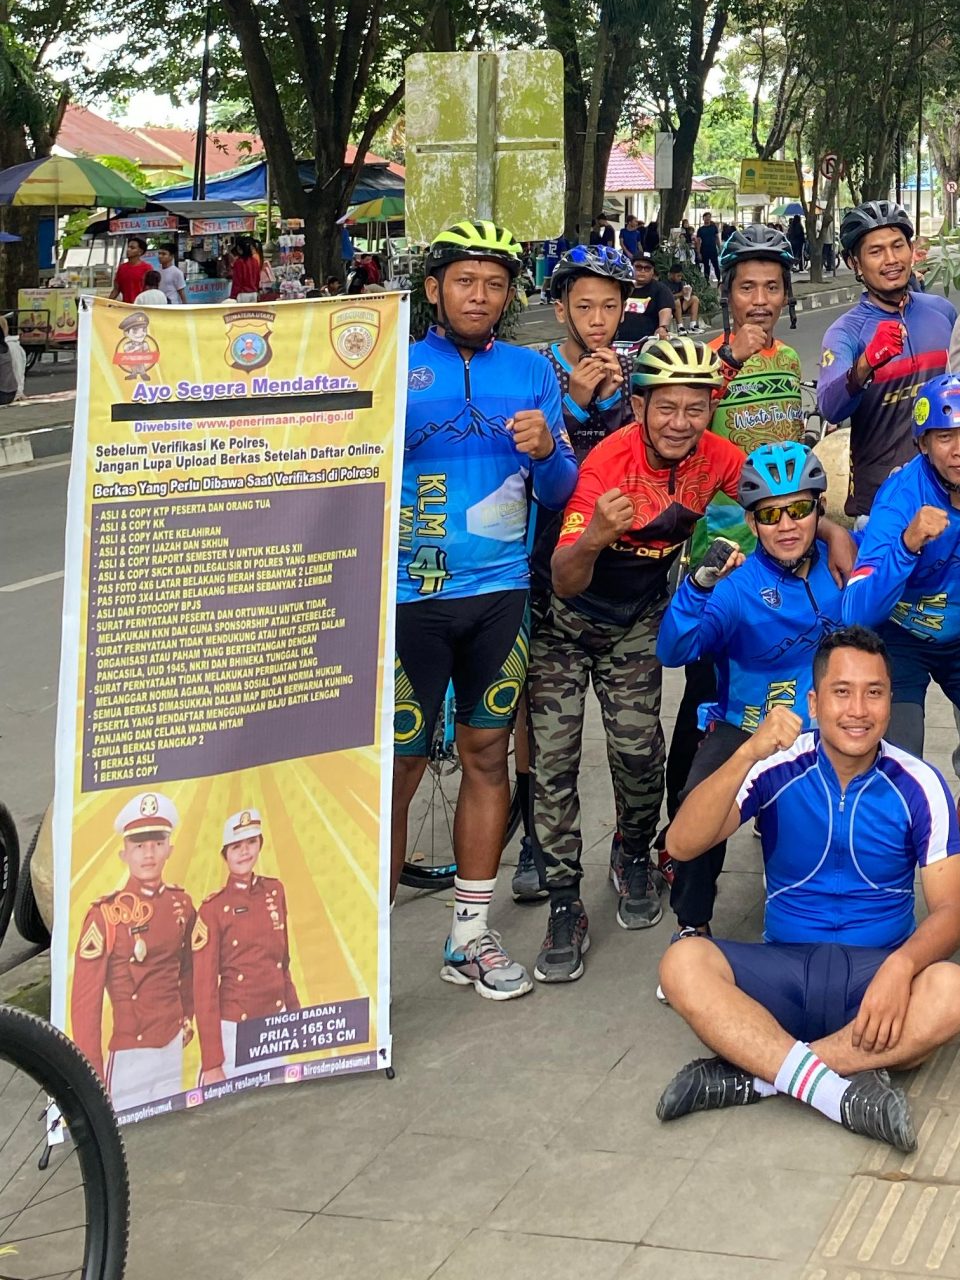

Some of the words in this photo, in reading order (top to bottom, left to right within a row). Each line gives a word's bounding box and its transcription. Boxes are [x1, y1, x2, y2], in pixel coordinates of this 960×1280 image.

[549, 244, 557, 254] 12
[133, 382, 171, 402] Ayo
[177, 379, 246, 400] Segera
[134, 420, 192, 432] Diwebsite
[196, 411, 353, 430] www.penerimaan.polri.go.id
[734, 410, 770, 430] Wisata
[96, 443, 147, 457] Sebelum
[151, 439, 206, 453] Verifikasi
[210, 438, 225, 450] Ke
[229, 436, 268, 451] Polres,
[95, 459, 138, 475] Jangan
[143, 457, 171, 472] Lupa
[176, 454, 216, 469] Upload
[220, 451, 260, 464] Berkas
[264, 448, 306, 461] Setelah
[310, 446, 344, 458] Daftar
[348, 443, 384, 455] Online.
[92, 482, 136, 498] Berkas
[138, 480, 168, 497] Yang
[170, 478, 200, 493] Perlu
[202, 475, 244, 491] Dibawa
[246, 473, 272, 487] Saat
[274, 469, 325, 485] Verifikasi
[327, 468, 337, 481] di
[339, 465, 371, 480] Polres
[100, 510, 118, 521] ASLI
[129, 507, 151, 518] COPY
[153, 506, 169, 516] KTP
[171, 503, 206, 515] PESERTA
[208, 502, 224, 512] DAN
[225, 500, 253, 511] ORANG
[255, 498, 270, 508] TUA
[416, 473, 447, 539] KLM
[407, 545, 452, 594] 4
[97, 608, 115, 620] ASLI
[117, 606, 134, 617] DAN
[136, 602, 178, 615] FOTOCOPY
[181, 599, 200, 610] BPJS
[93, 707, 121, 721] SEMUA
[124, 702, 156, 717] BERKAS
[159, 695, 212, 712] DIMASUKKAN
[214, 692, 241, 705] DALAM
[243, 690, 259, 701] MAP
[261, 687, 282, 698] BIOLA
[284, 679, 323, 694] BERWARNA
[324, 674, 353, 687] KUNING
[94, 730, 133, 746] PANJANG
[135, 728, 152, 740] DAN
[155, 723, 186, 737] CELANA
[188, 720, 217, 733] WARNA
[219, 717, 243, 730] HITAM
[91, 744, 120, 759] SEMUA
[122, 740, 155, 754] BERKAS
[157, 734, 197, 751] RANGKAP
[100, 755, 134, 770] BERKAS
[136, 753, 154, 765] ASLI
[100, 768, 133, 782] BERKAS
[136, 765, 157, 777] COPY
[265, 1012, 299, 1026] TINGGI
[302, 1006, 336, 1019] BADAN
[260, 1028, 290, 1043] PRIA
[301, 1022, 323, 1035] 165
[327, 1018, 346, 1030] CM
[249, 1039, 299, 1058] WANITA
[311, 1034, 332, 1046] 163
[336, 1029, 356, 1042] CM
